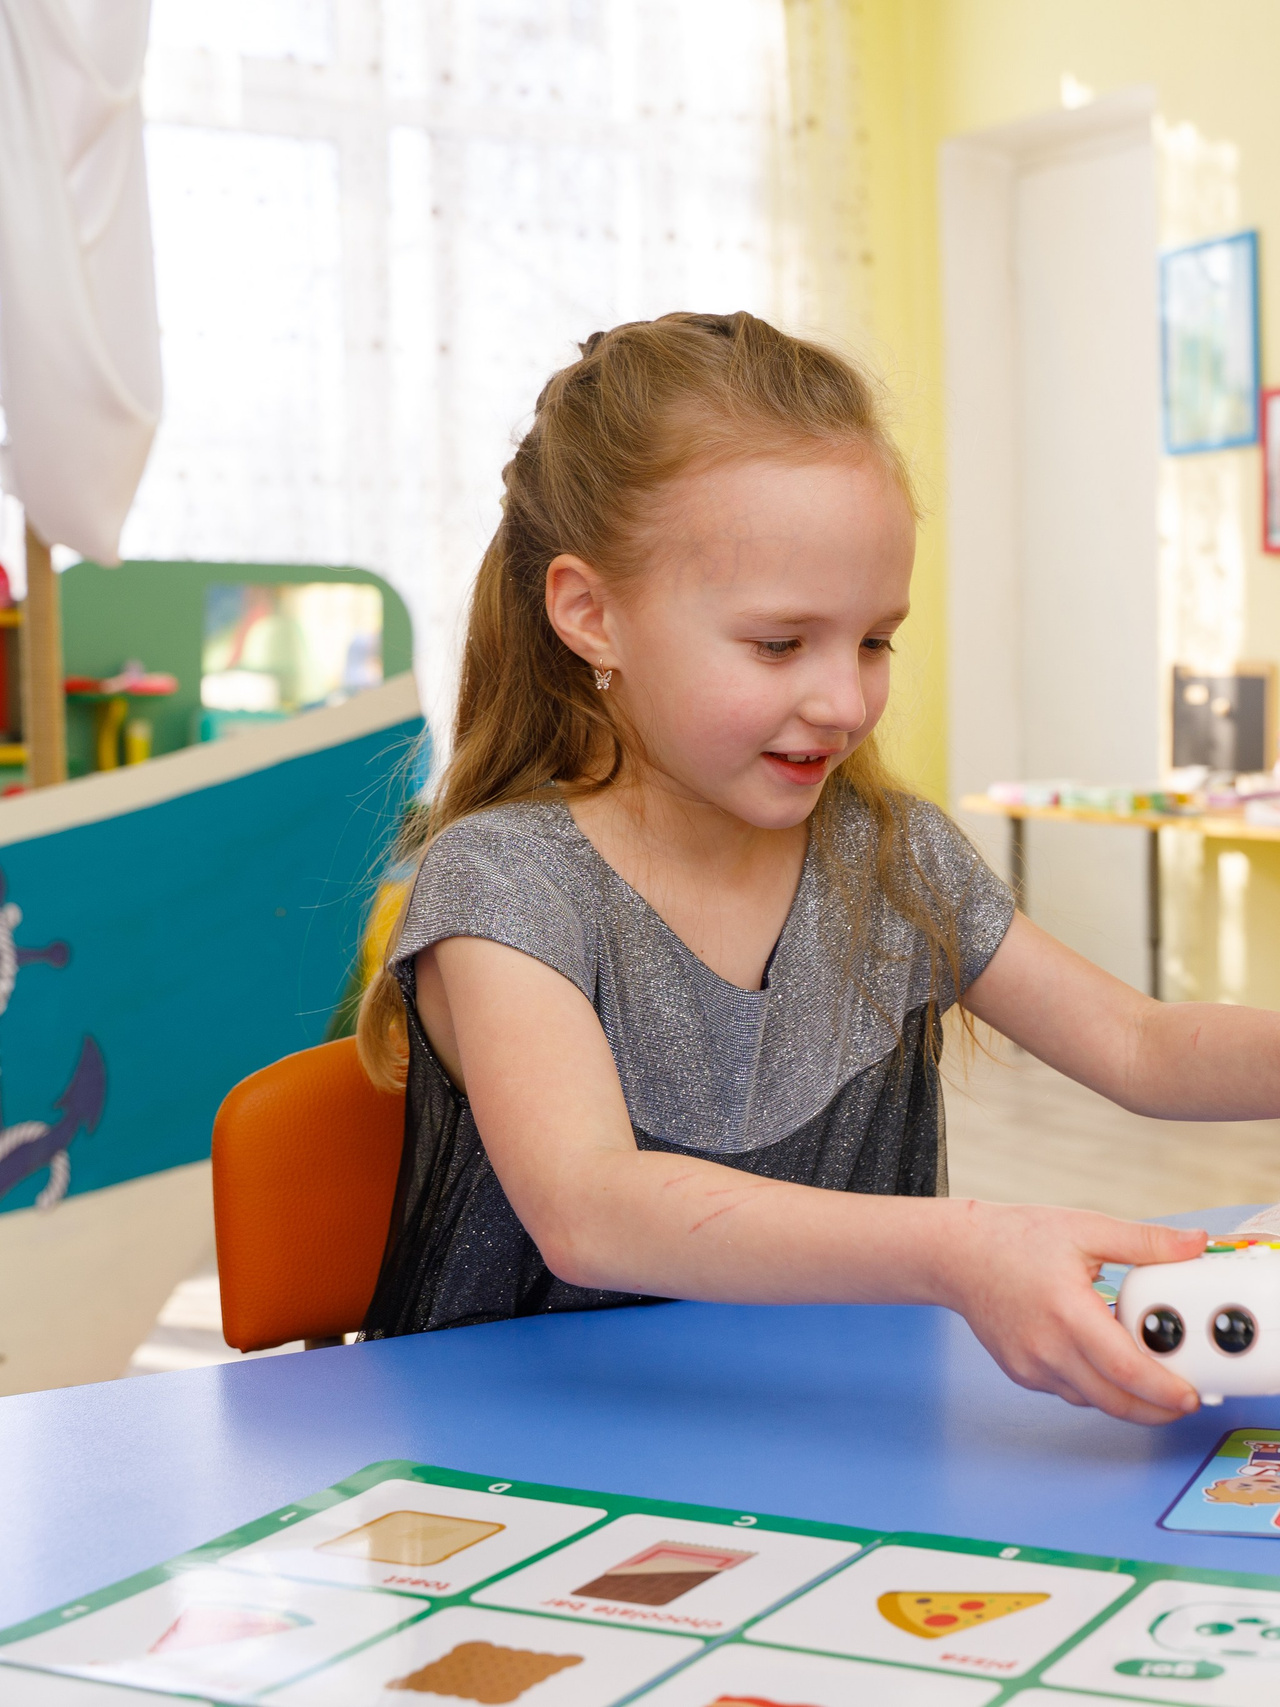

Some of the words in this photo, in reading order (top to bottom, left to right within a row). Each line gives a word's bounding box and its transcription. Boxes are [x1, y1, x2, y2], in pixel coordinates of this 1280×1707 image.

[487, 1482, 513, 1494] D
[732, 1515, 758, 1527] C
[382, 1575, 451, 1591] toast
[539, 1598, 587, 1612] bar
[592, 1604, 723, 1629] chocolate
[939, 1652, 1019, 1671] pizza
[1139, 1661, 1197, 1678] go!
